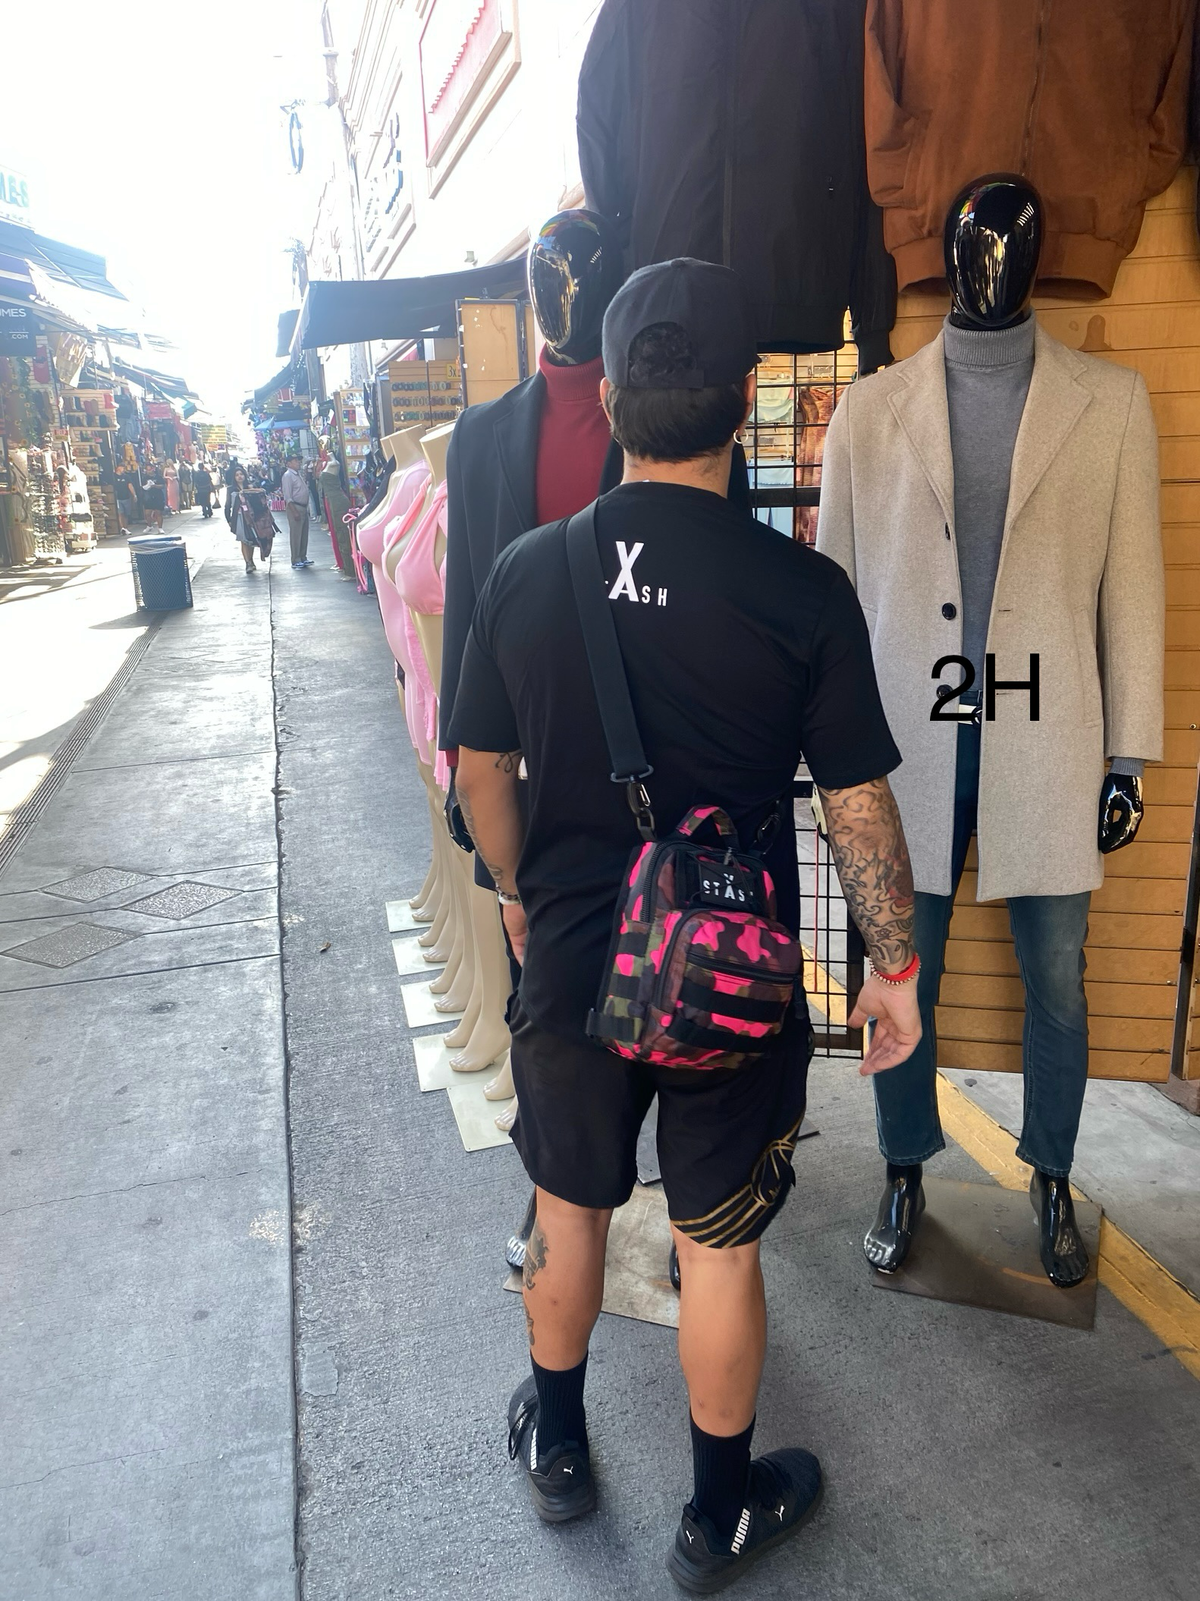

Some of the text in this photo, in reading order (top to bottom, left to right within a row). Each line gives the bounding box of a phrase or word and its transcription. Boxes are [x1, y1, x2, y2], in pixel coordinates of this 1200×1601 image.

[0, 308, 27, 318] MES
[703, 873, 754, 902] STAS
[730, 1507, 751, 1555] PUMA
